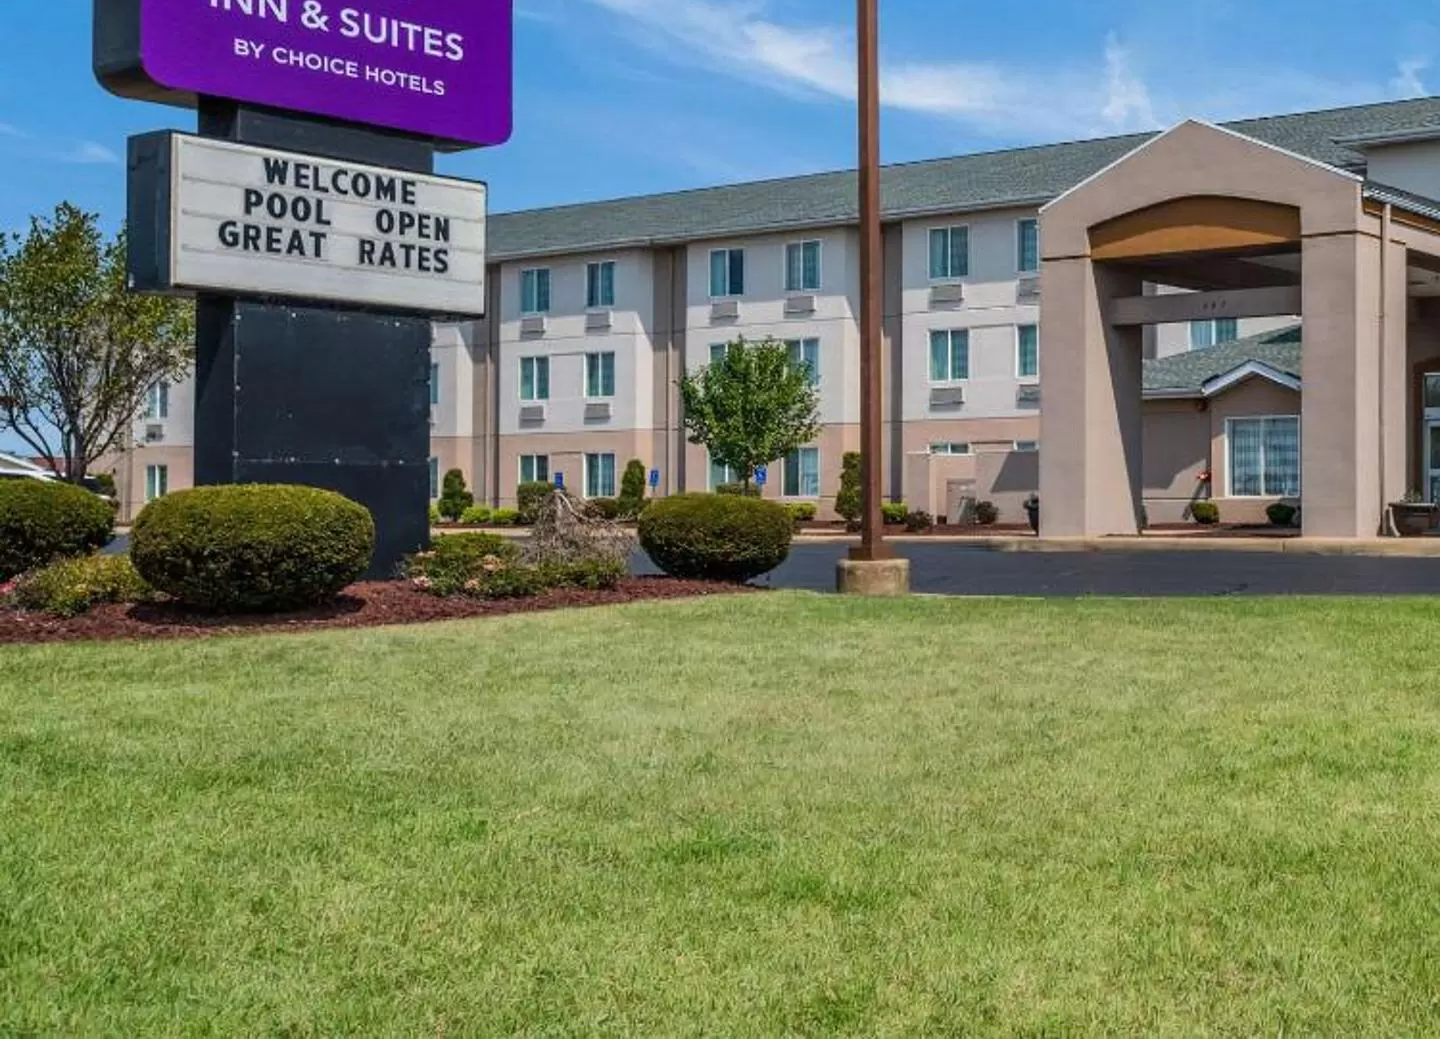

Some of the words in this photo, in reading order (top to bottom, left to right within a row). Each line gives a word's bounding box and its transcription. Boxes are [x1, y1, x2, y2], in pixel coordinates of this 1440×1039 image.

[301, 0, 329, 32] &
[340, 8, 465, 61] SUITES
[233, 38, 265, 59] BY
[272, 47, 358, 78] CHOICE
[365, 65, 446, 96] HOTELS
[263, 157, 416, 205] WELCOME
[244, 188, 331, 226] POOL
[376, 209, 450, 242] OPEN
[218, 220, 327, 258] GREAT
[359, 239, 449, 273] RATES
